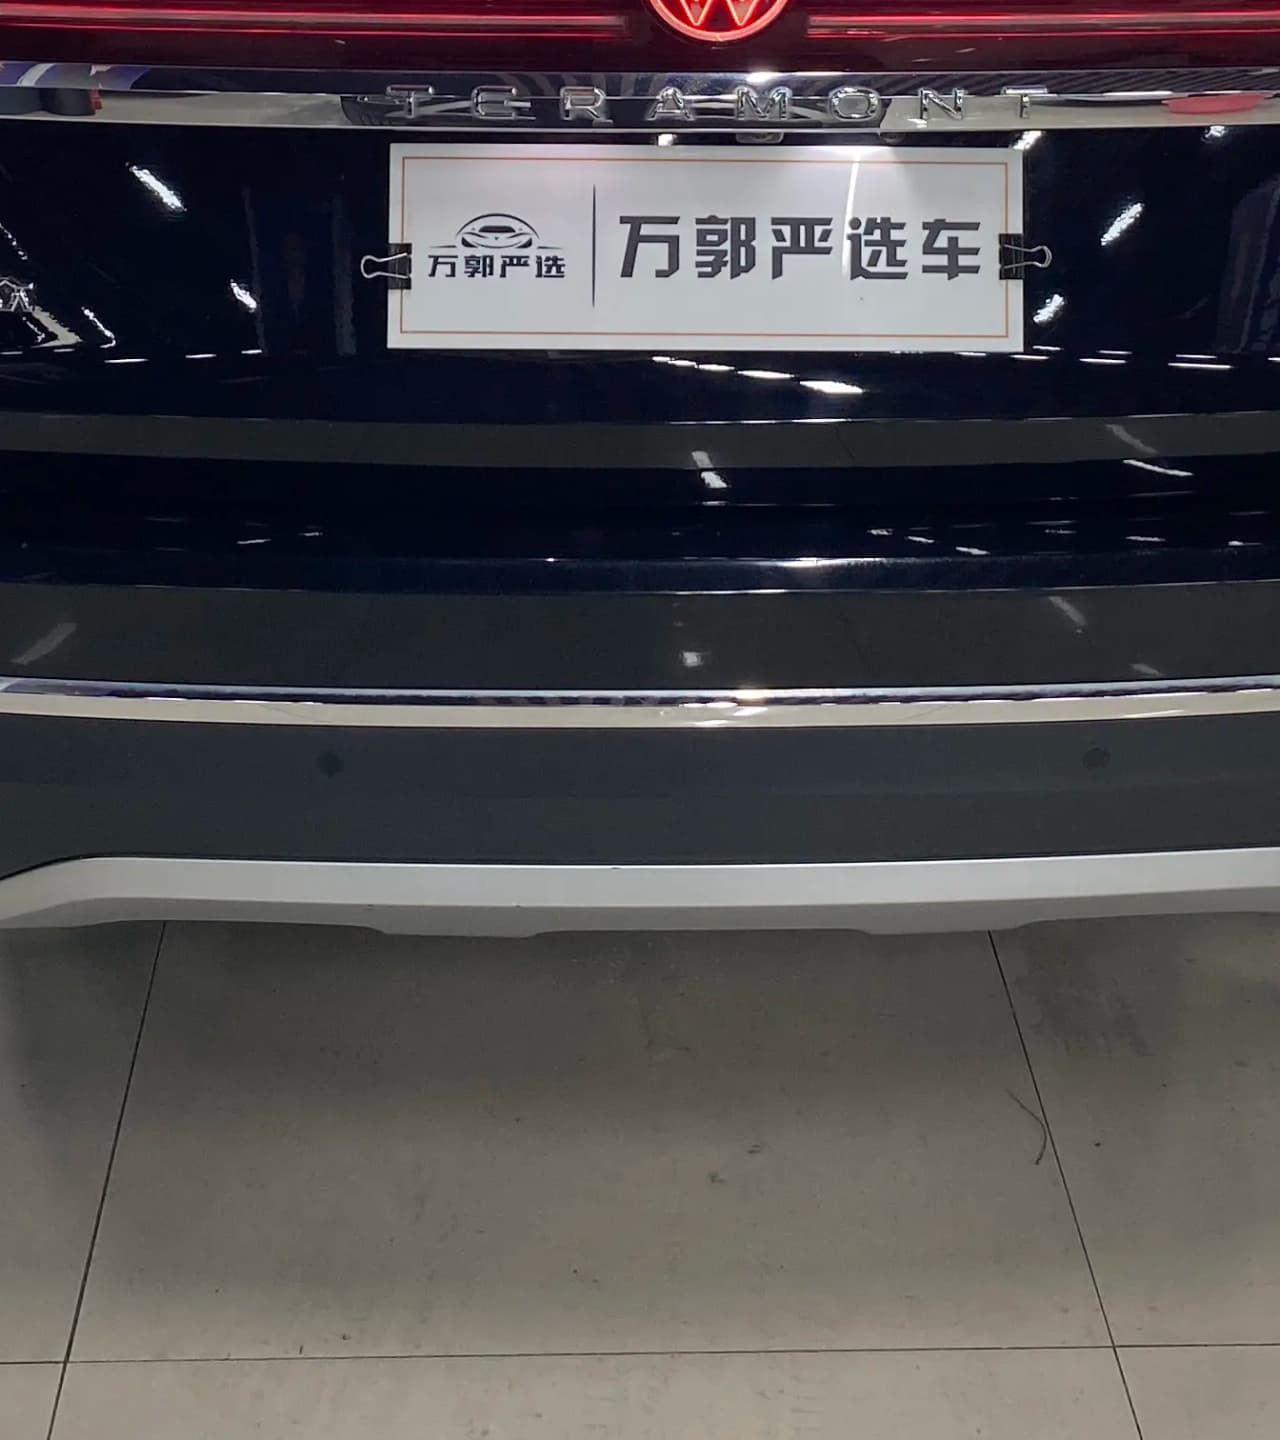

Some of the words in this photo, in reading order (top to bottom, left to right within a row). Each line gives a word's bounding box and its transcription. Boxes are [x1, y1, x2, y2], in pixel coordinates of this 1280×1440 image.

[386, 85, 1048, 120] TERAMONT
[619, 215, 982, 280] 万郭严选车
[428, 255, 566, 279] 万郭严选
